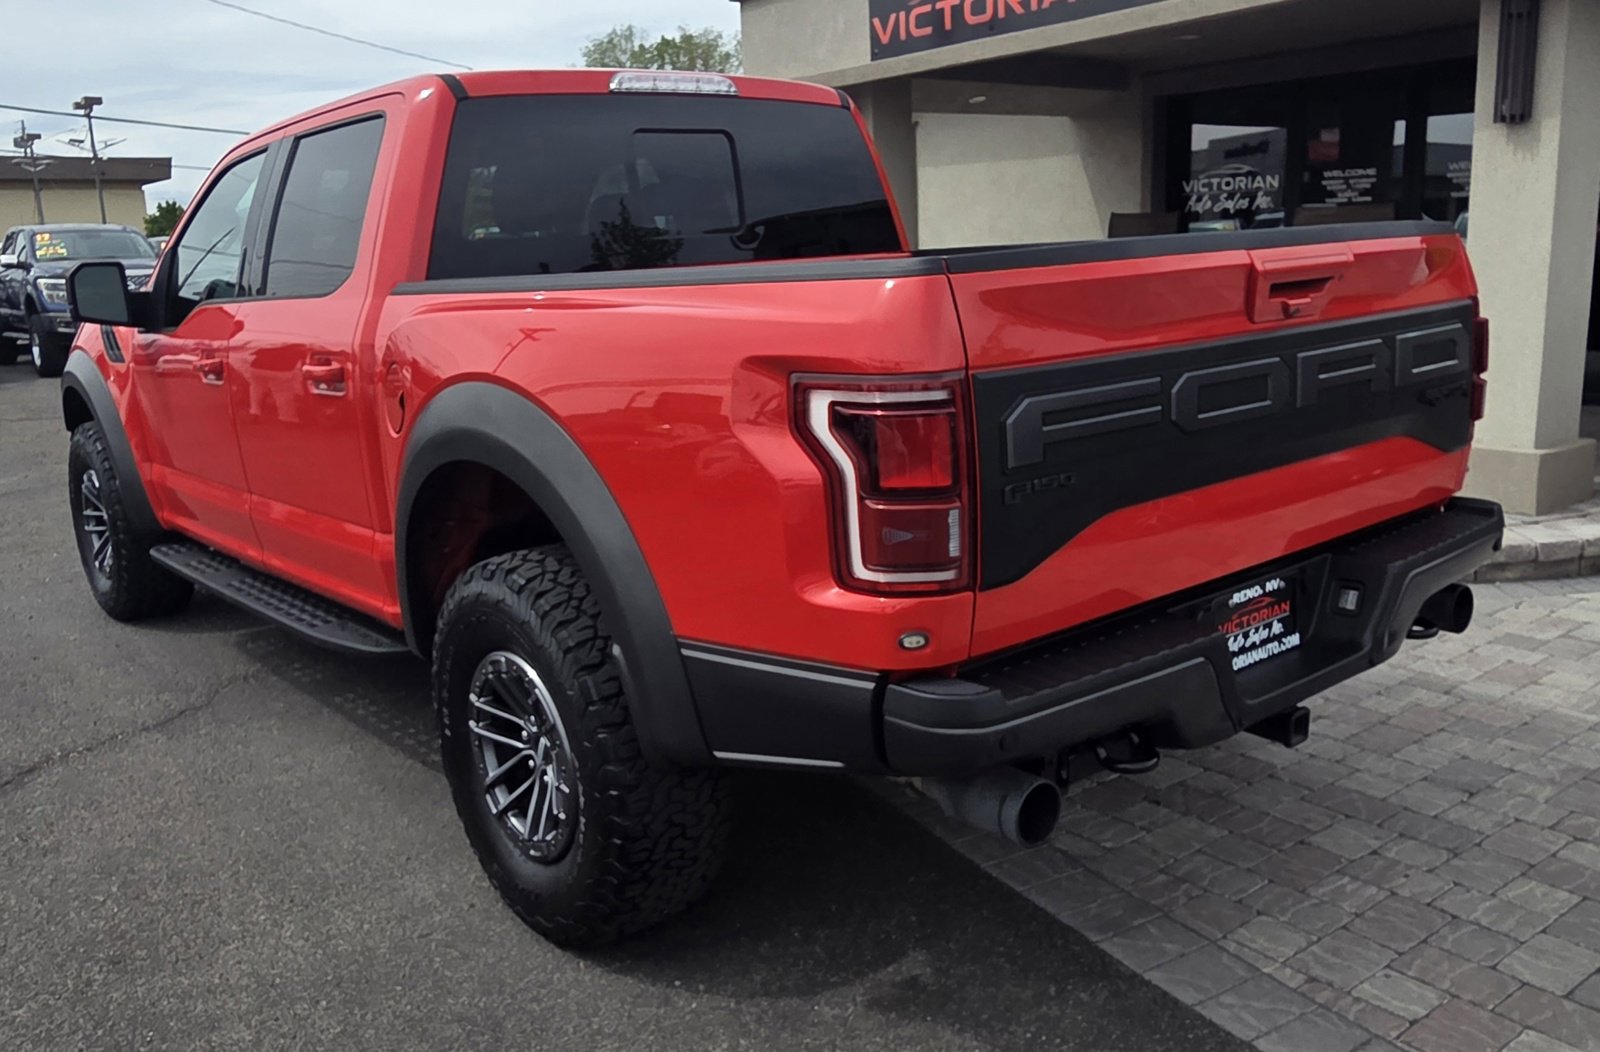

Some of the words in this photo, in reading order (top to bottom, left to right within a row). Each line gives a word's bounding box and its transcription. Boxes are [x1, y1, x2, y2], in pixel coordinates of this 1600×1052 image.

[872, 0, 1077, 44] VICTOR
[1182, 174, 1279, 193] VICTORIAN
[1006, 322, 1470, 470] FORD
[1265, 578, 1280, 593] NV
[1218, 600, 1290, 634] VICTORIAN
